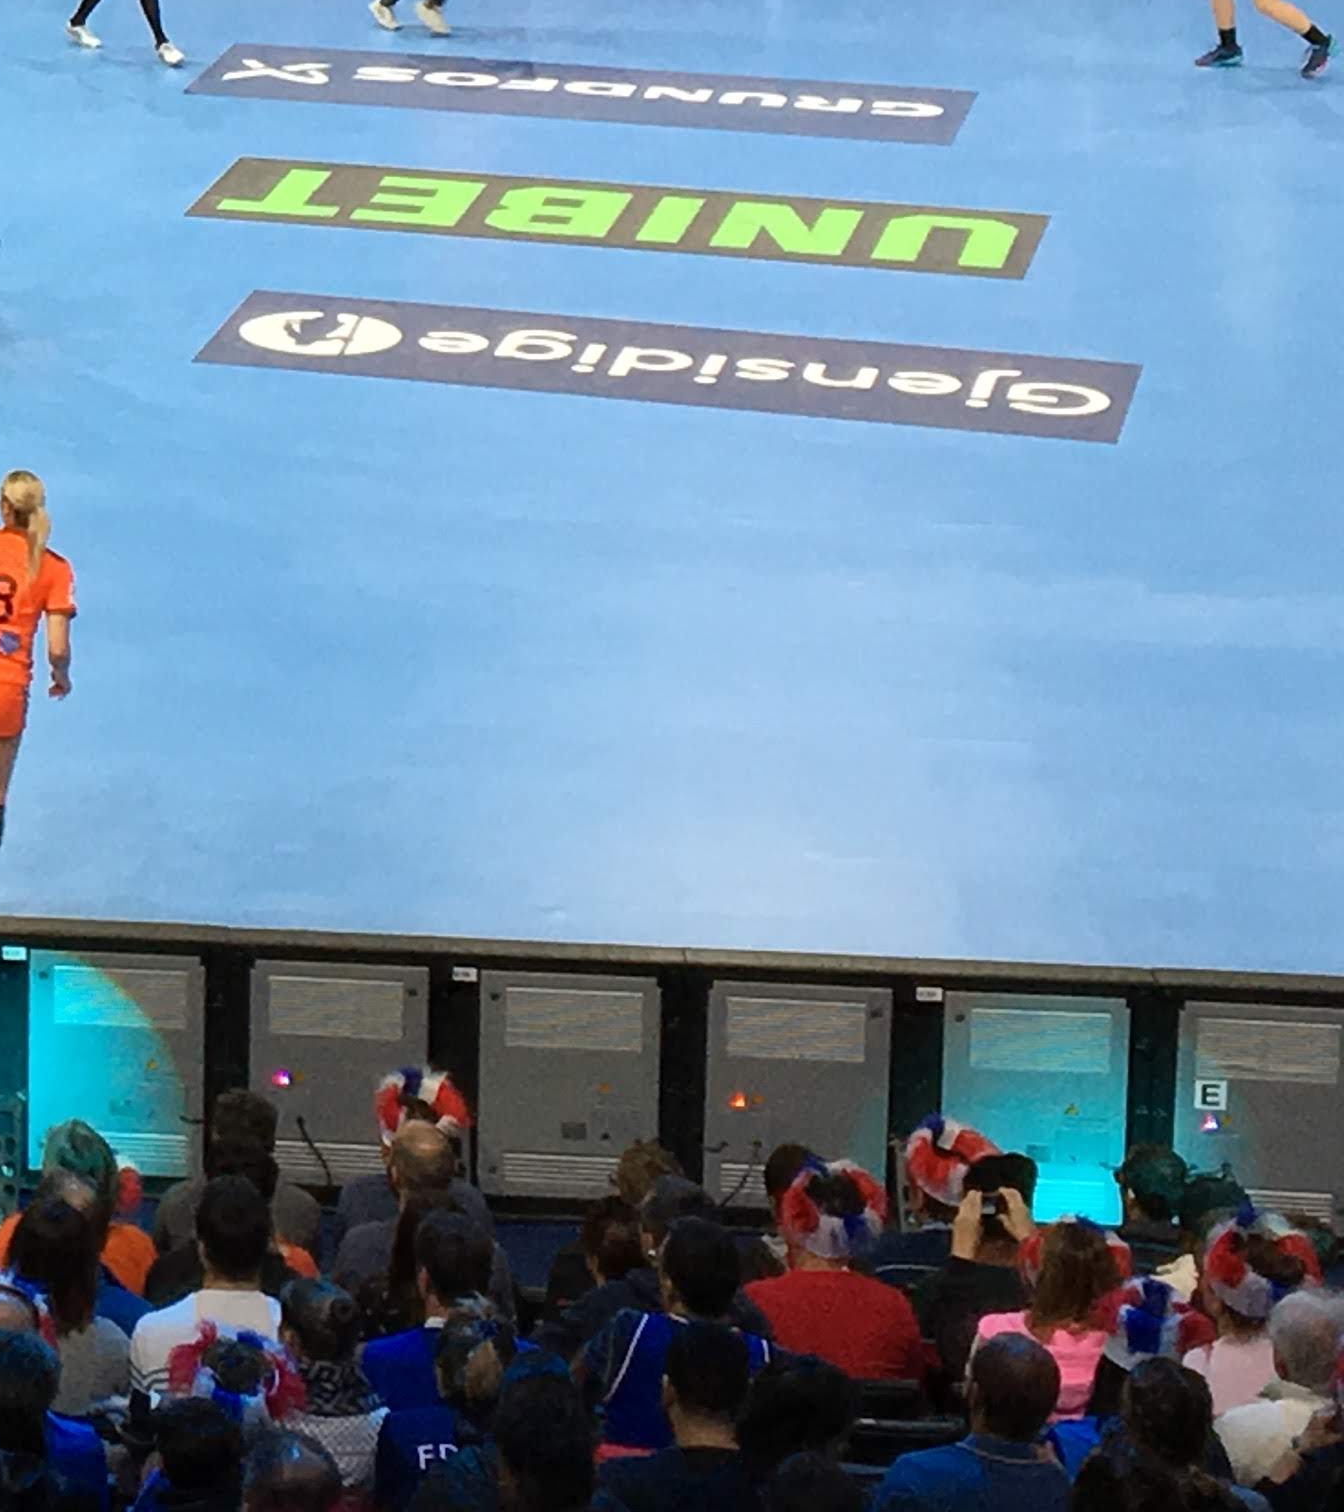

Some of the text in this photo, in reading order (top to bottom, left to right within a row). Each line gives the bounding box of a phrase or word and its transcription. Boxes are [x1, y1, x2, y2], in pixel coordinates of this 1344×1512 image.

[352, 63, 946, 120] GRUNDFOS
[215, 166, 1019, 270] UNIBET
[417, 327, 1113, 418] Gjensidige
[1200, 1083, 1220, 1106] E
